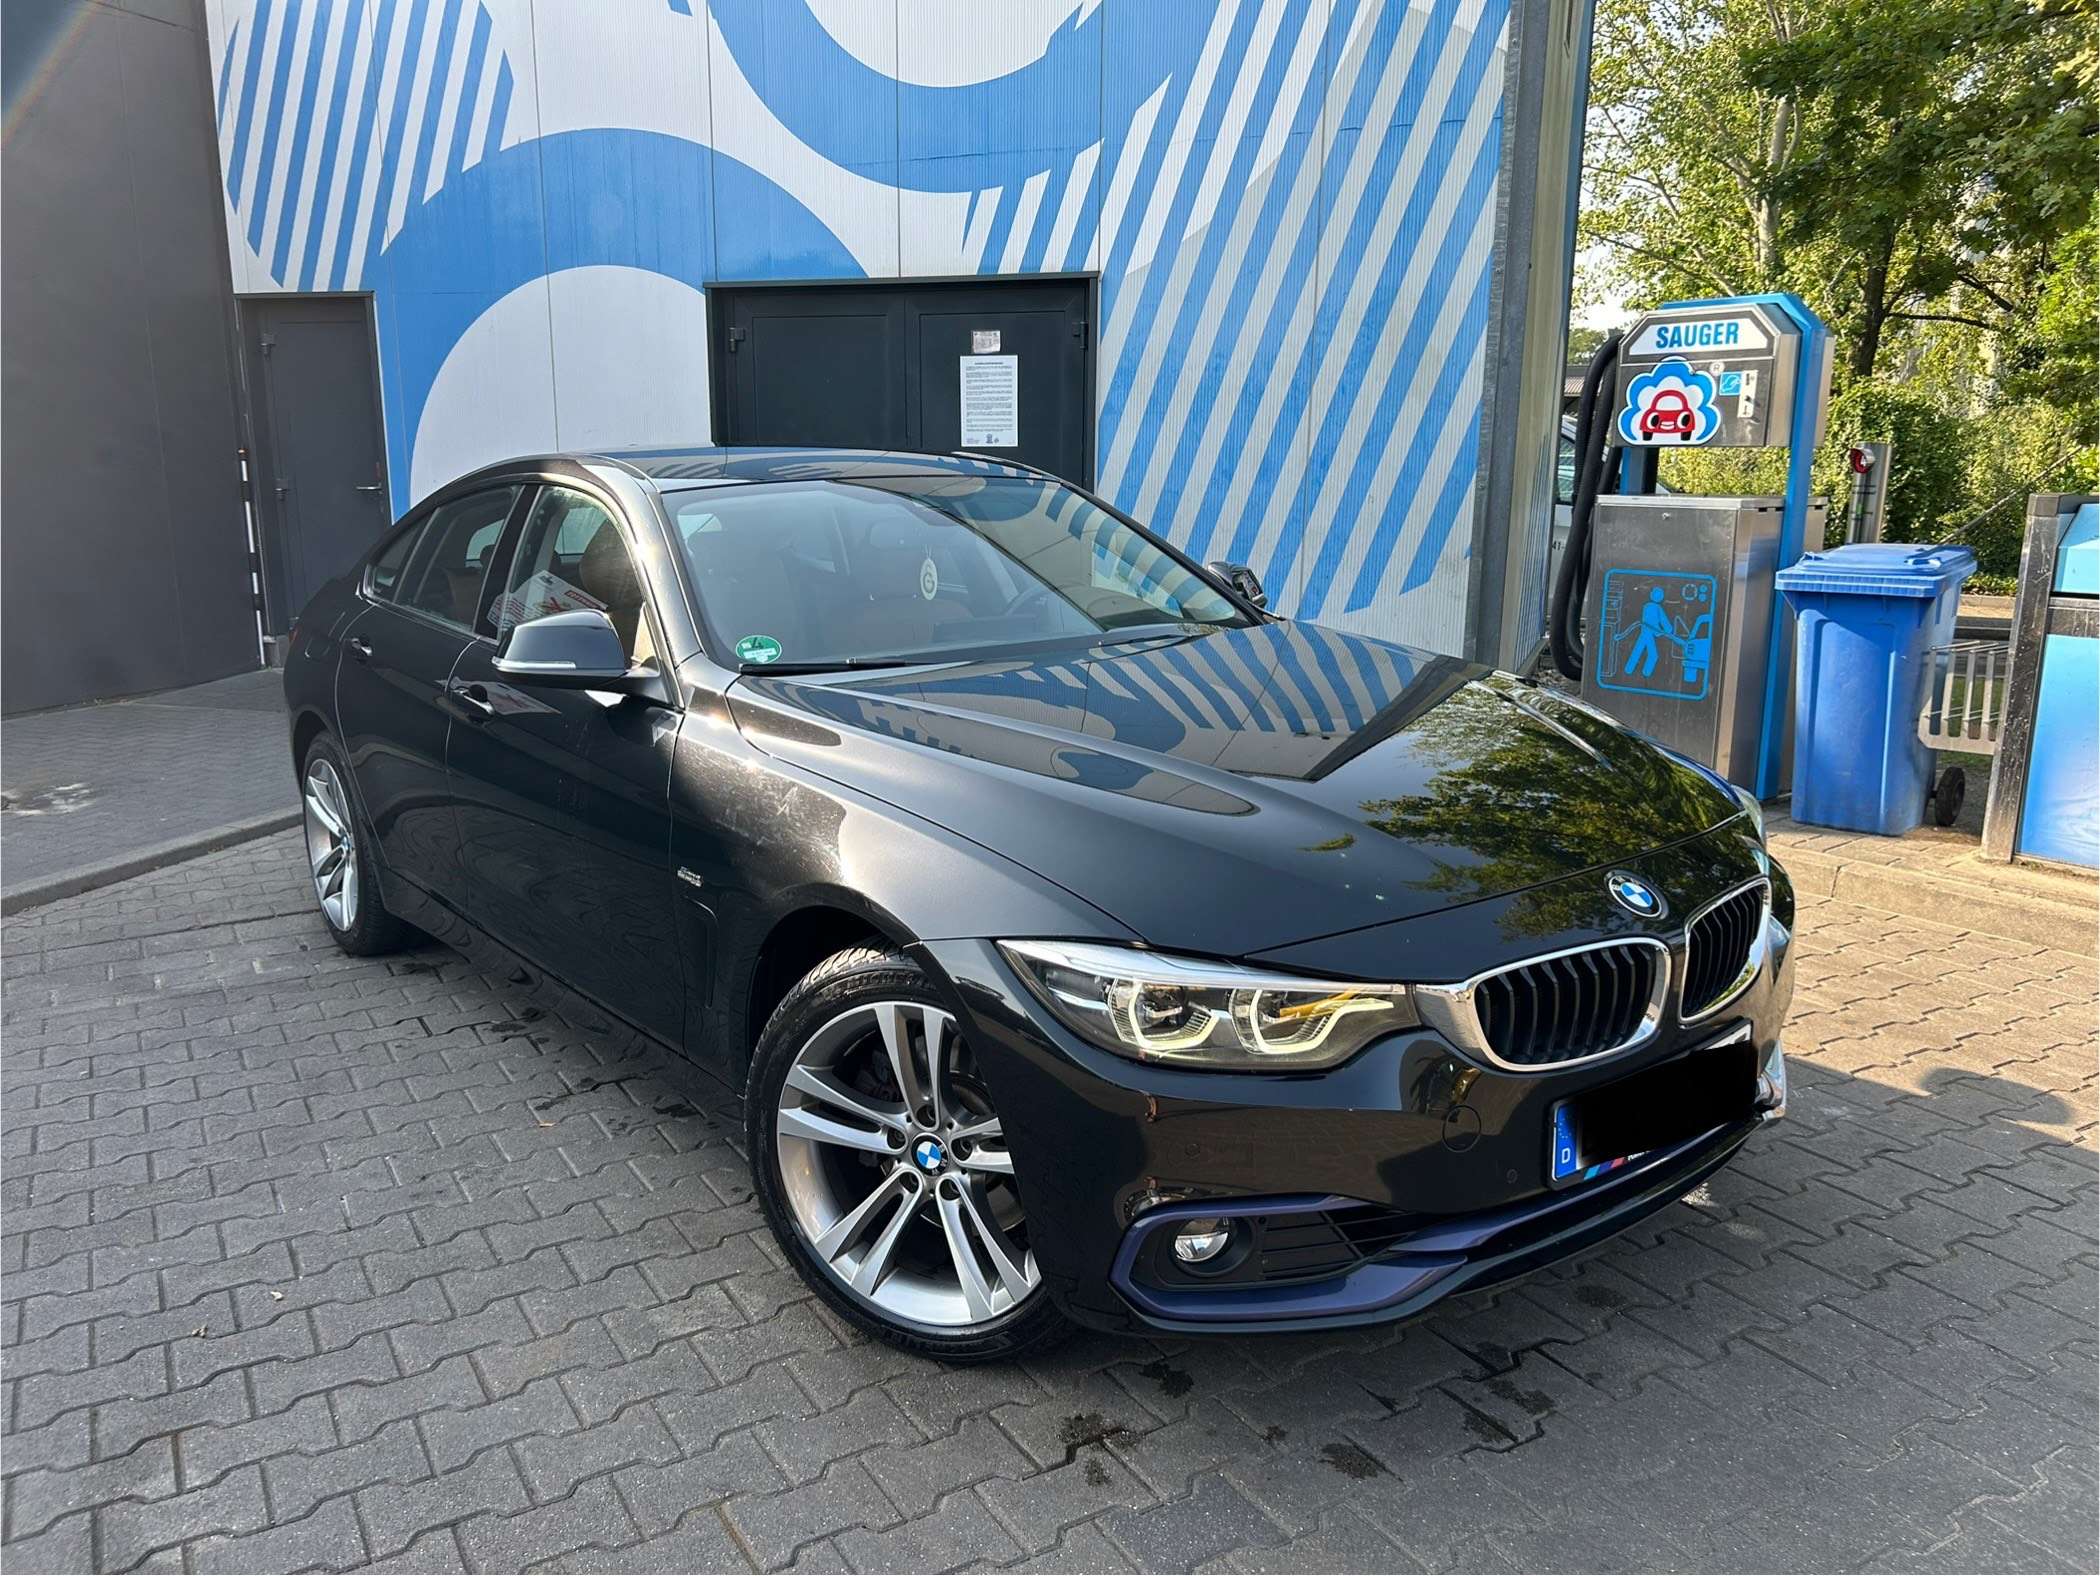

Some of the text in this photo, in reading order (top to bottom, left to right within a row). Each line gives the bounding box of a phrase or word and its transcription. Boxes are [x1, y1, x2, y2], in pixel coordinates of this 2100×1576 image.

[1656, 322, 1739, 348] SAUGER
[751, 637, 764, 649] 4
[1561, 1148, 1571, 1164] D
